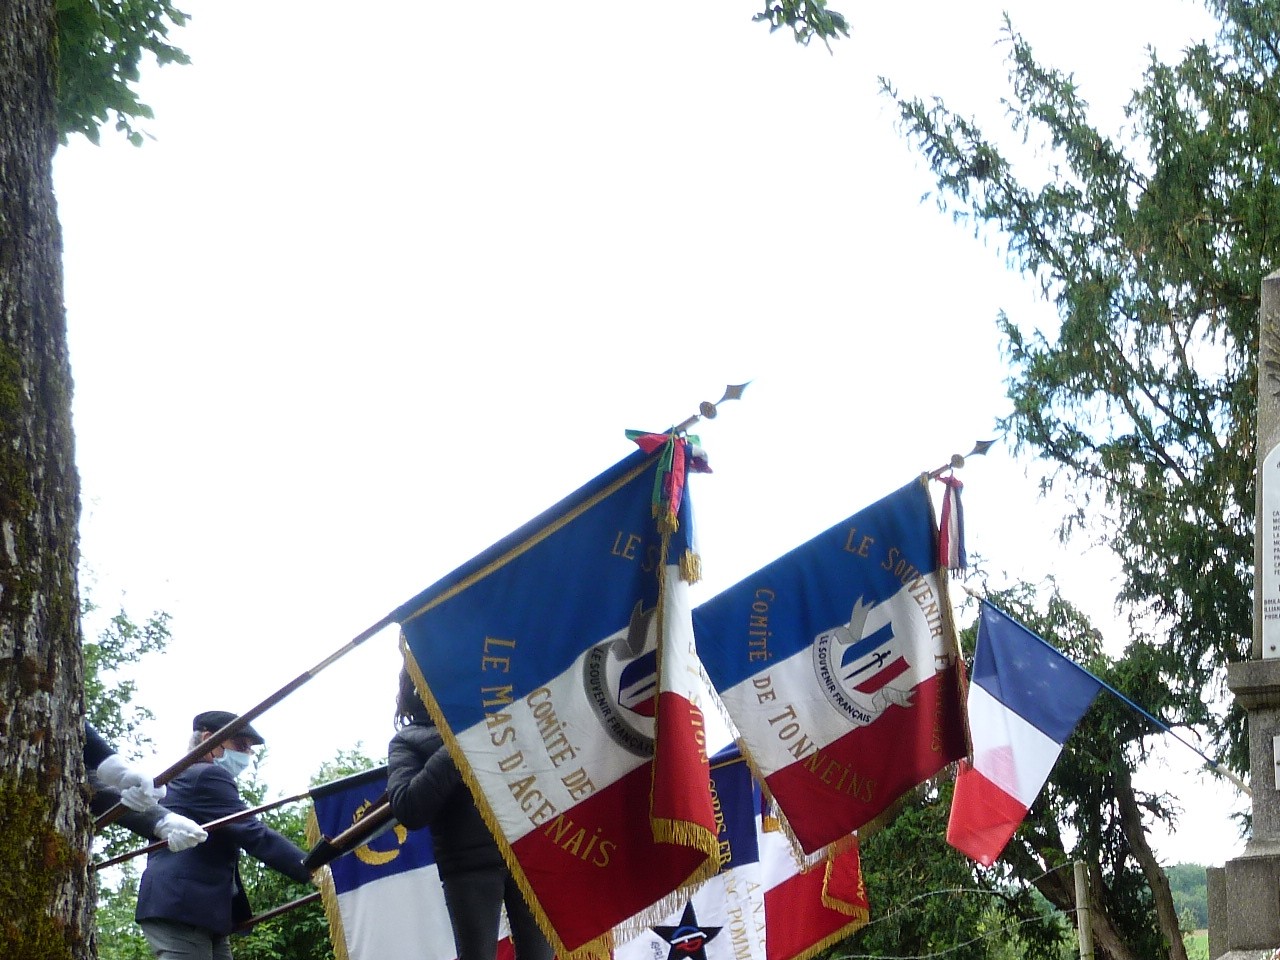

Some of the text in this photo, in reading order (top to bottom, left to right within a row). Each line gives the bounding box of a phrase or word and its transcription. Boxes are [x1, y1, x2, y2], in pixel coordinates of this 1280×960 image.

[609, 531, 641, 560] LE
[844, 528, 876, 558] LE
[882, 547, 943, 641] SOUVENIR
[482, 636, 516, 672] LE
[589, 662, 612, 719] SOUVENIR
[817, 635, 872, 724] LE SOUVENIR FRANÇAIS
[481, 684, 516, 747] MAS
[748, 589, 878, 802] COMITÉ DE TONNEINS
[526, 687, 597, 801] COMITÉ DE
